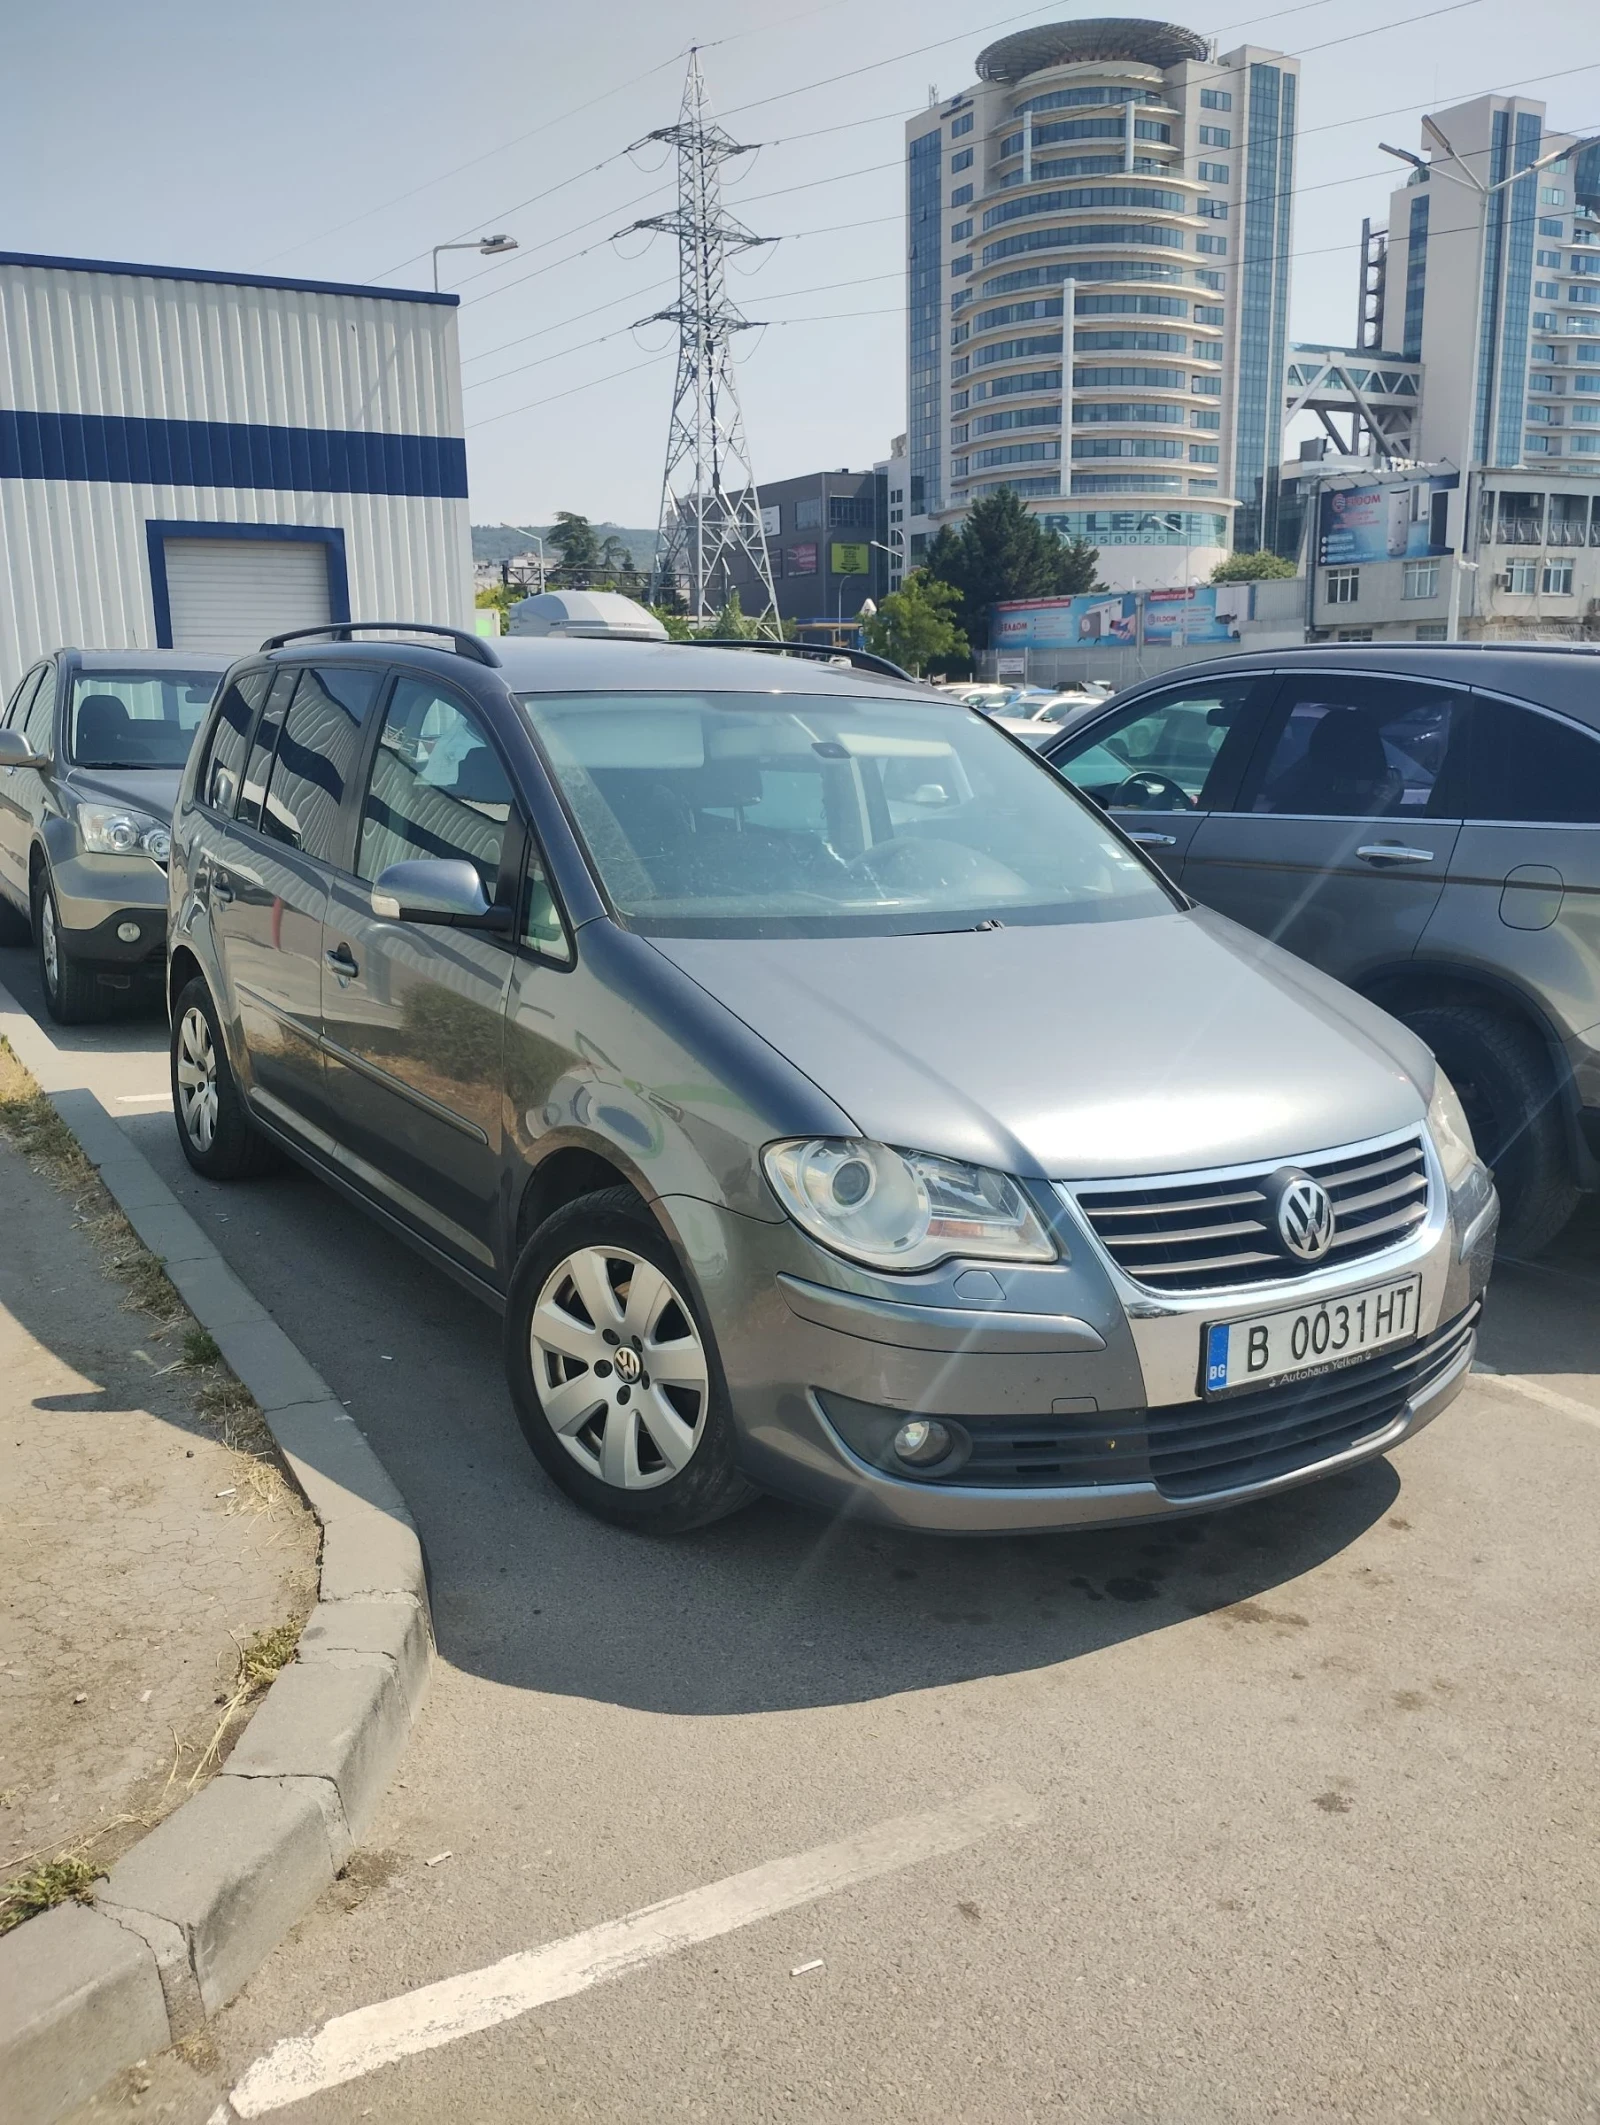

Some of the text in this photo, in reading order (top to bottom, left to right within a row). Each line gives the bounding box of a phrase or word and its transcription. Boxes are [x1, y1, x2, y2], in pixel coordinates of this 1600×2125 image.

[1042, 513, 1202, 533] R LEASE
[1247, 1325, 1269, 1372] B
[1209, 1364, 1226, 1380] BG
[1279, 1364, 1329, 1384] Autohaus
